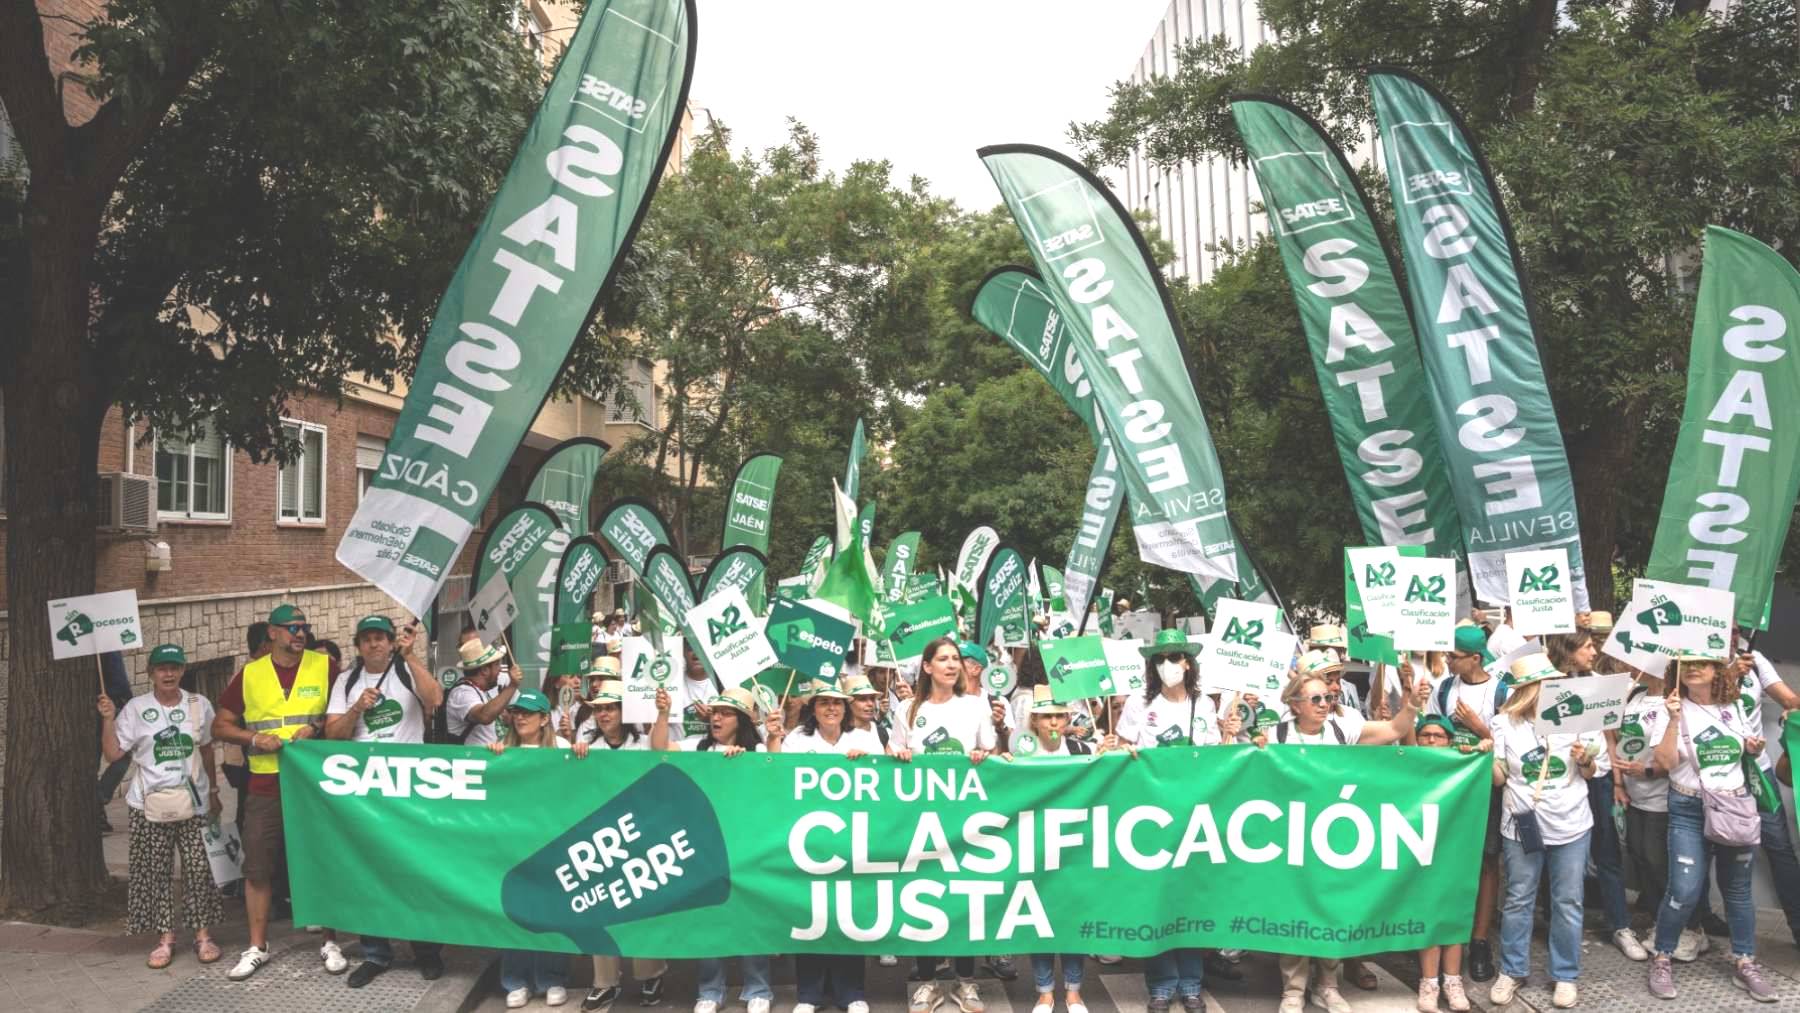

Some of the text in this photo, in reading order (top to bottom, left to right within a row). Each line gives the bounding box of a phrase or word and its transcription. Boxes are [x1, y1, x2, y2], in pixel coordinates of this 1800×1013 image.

[1281, 198, 1344, 224] SATSE
[1040, 308, 1060, 360] SATSE
[1303, 238, 1436, 546] SATSE
[544, 499, 580, 514] SATSE
[735, 491, 768, 511] SATSE
[732, 511, 765, 531] JAÉN
[490, 513, 535, 564] SATSE
[502, 527, 546, 573] Cádiz
[564, 548, 593, 593] SATSE
[889, 544, 911, 602] SATS
[960, 534, 990, 583] SATSE
[572, 564, 602, 603] Cádiz
[1404, 573, 1447, 605] A2
[1518, 563, 1561, 593] A2
[65, 609, 79, 621] sin
[1650, 594, 1668, 606] sin
[707, 602, 748, 646] A2
[787, 624, 843, 655] Respeto
[1222, 616, 1264, 650] A2
[1109, 664, 1141, 672] ocesos
[1216, 647, 1265, 662] Clasificación
[1228, 658, 1249, 668] Justa
[1555, 690, 1572, 702] sin
[319, 754, 486, 801] SATSE
[793, 767, 988, 801] POR UNA
[788, 784, 1440, 875] CLASIFICACIÓN
[554, 812, 642, 892] ERRE
[571, 829, 696, 914] QUE ERRE
[790, 879, 1055, 942] JUSTA
[1079, 915, 1426, 943] #ErreQueErre #ClasificaciónJusta
